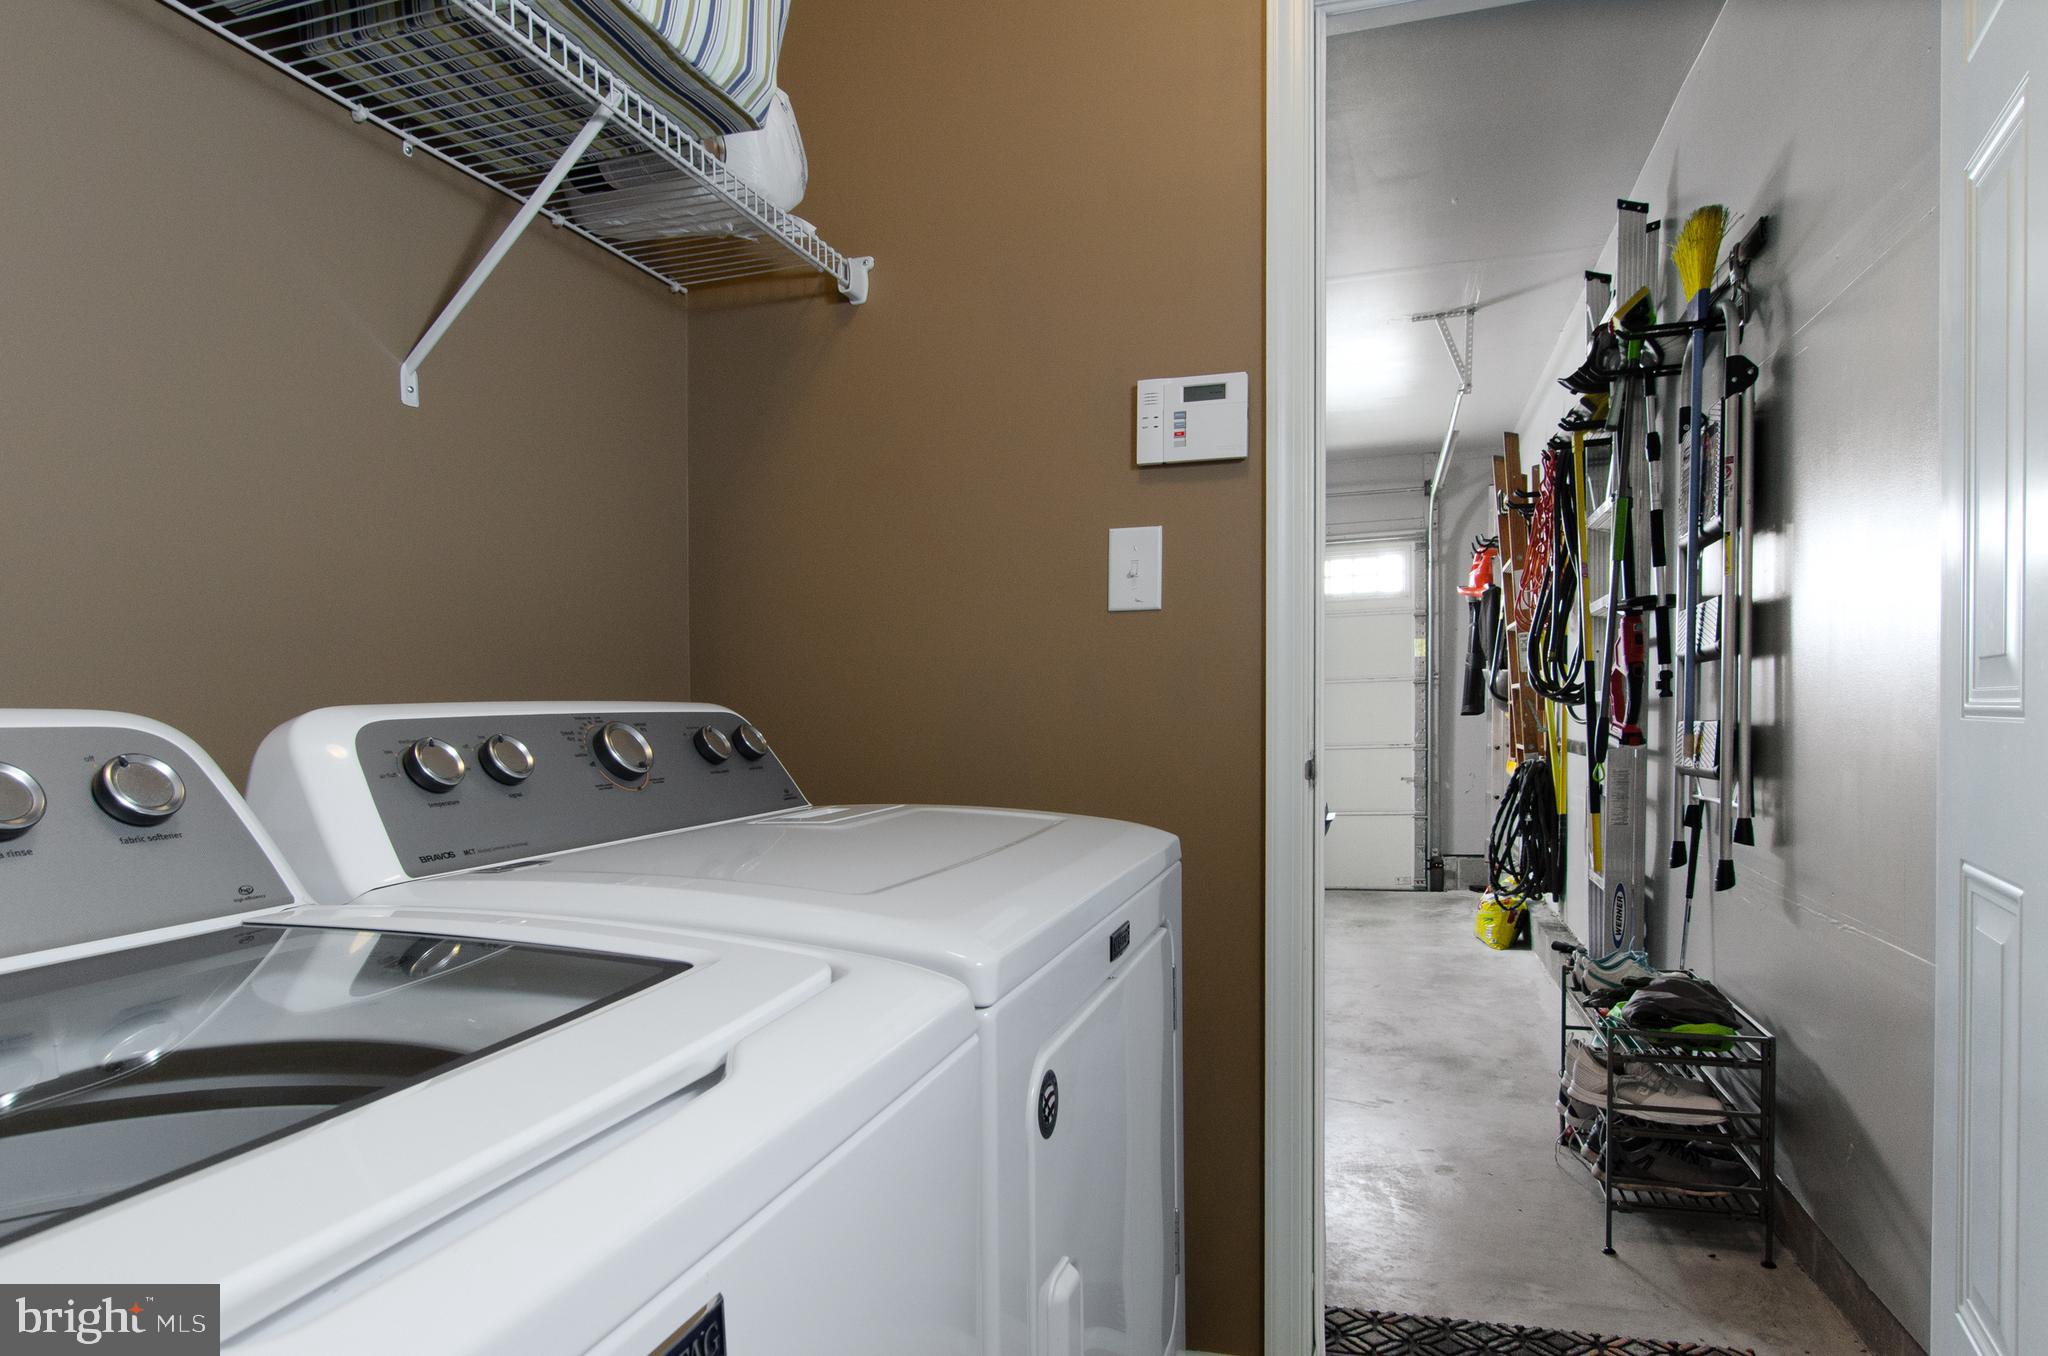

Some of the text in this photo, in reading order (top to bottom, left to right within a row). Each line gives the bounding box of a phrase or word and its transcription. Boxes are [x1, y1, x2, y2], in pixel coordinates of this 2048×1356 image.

[119, 832, 183, 845] fabric softener
[6, 848, 34, 858] rinse
[418, 851, 456, 864] BRAVOS
[1615, 895, 1624, 936] WERNER
